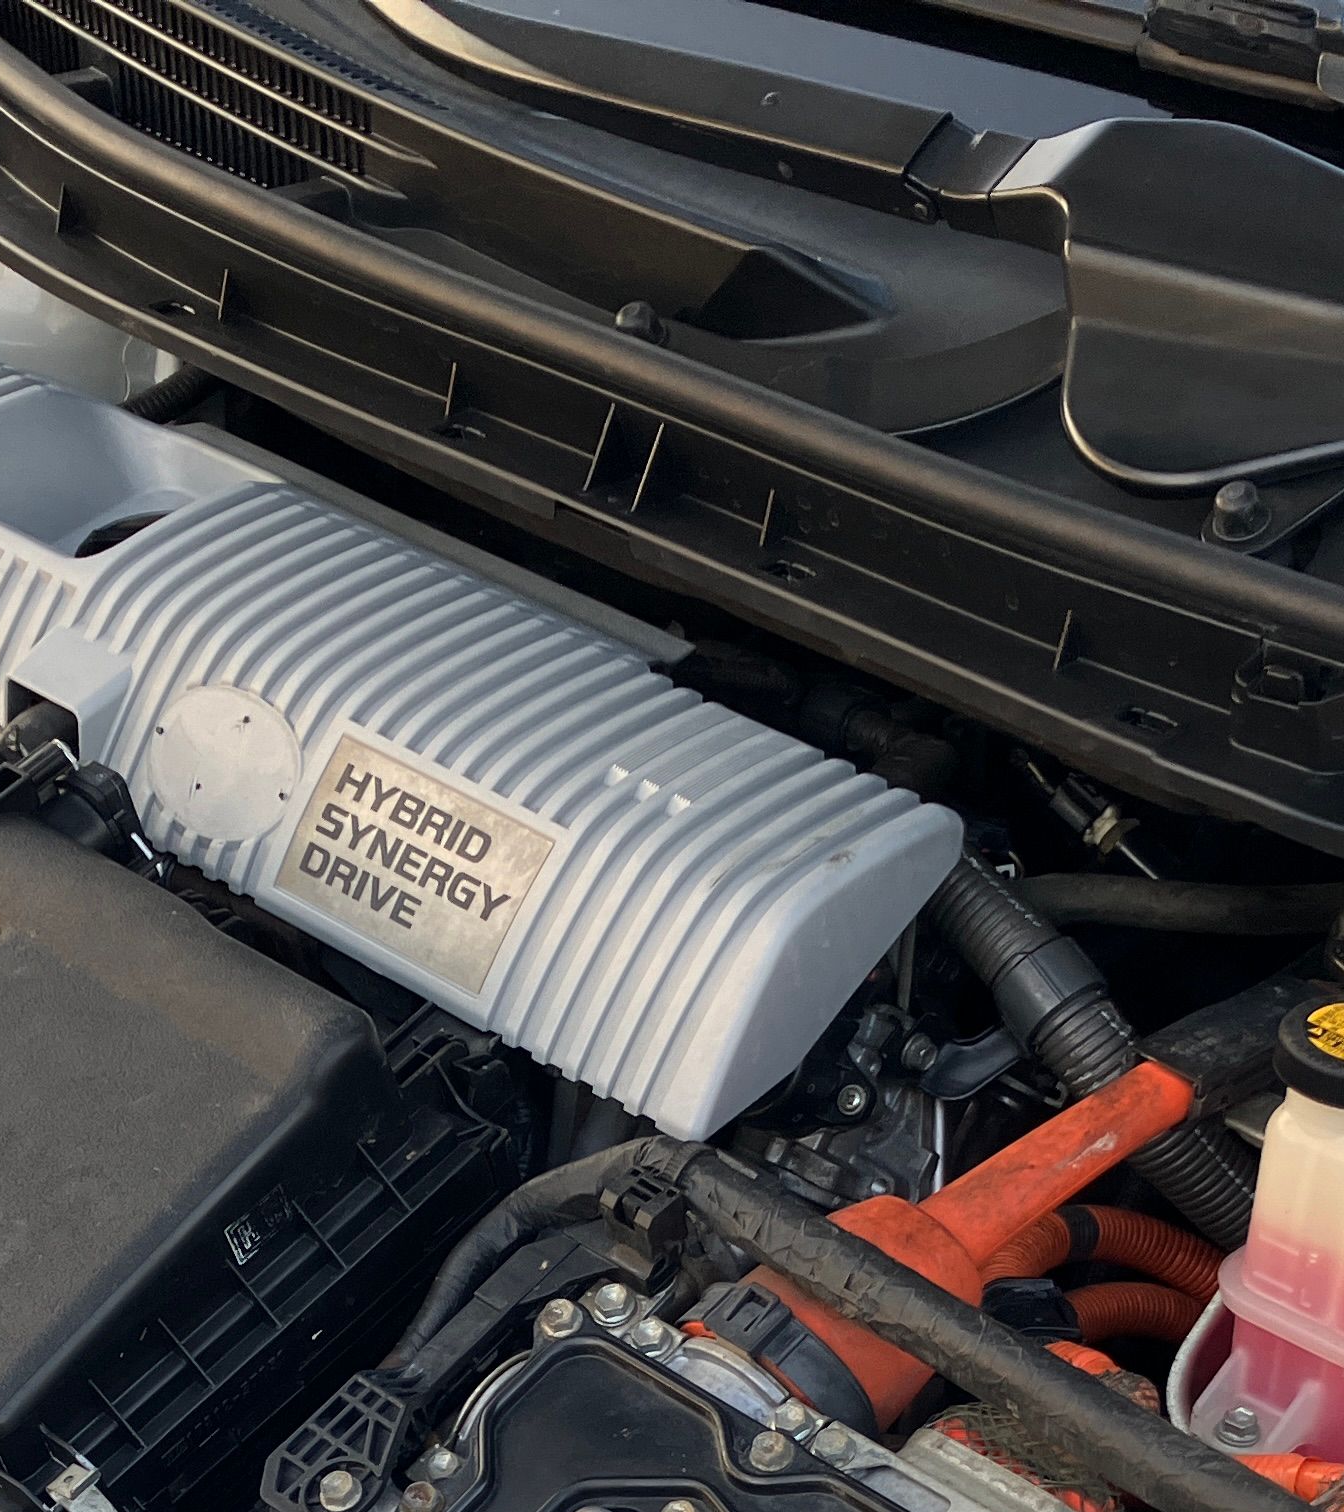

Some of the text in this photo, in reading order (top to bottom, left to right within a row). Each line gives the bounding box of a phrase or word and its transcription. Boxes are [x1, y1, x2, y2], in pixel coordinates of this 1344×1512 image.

[316, 803, 510, 921] SYNERGY
[335, 763, 492, 864] HYBRID
[299, 842, 422, 929] DRIVE
